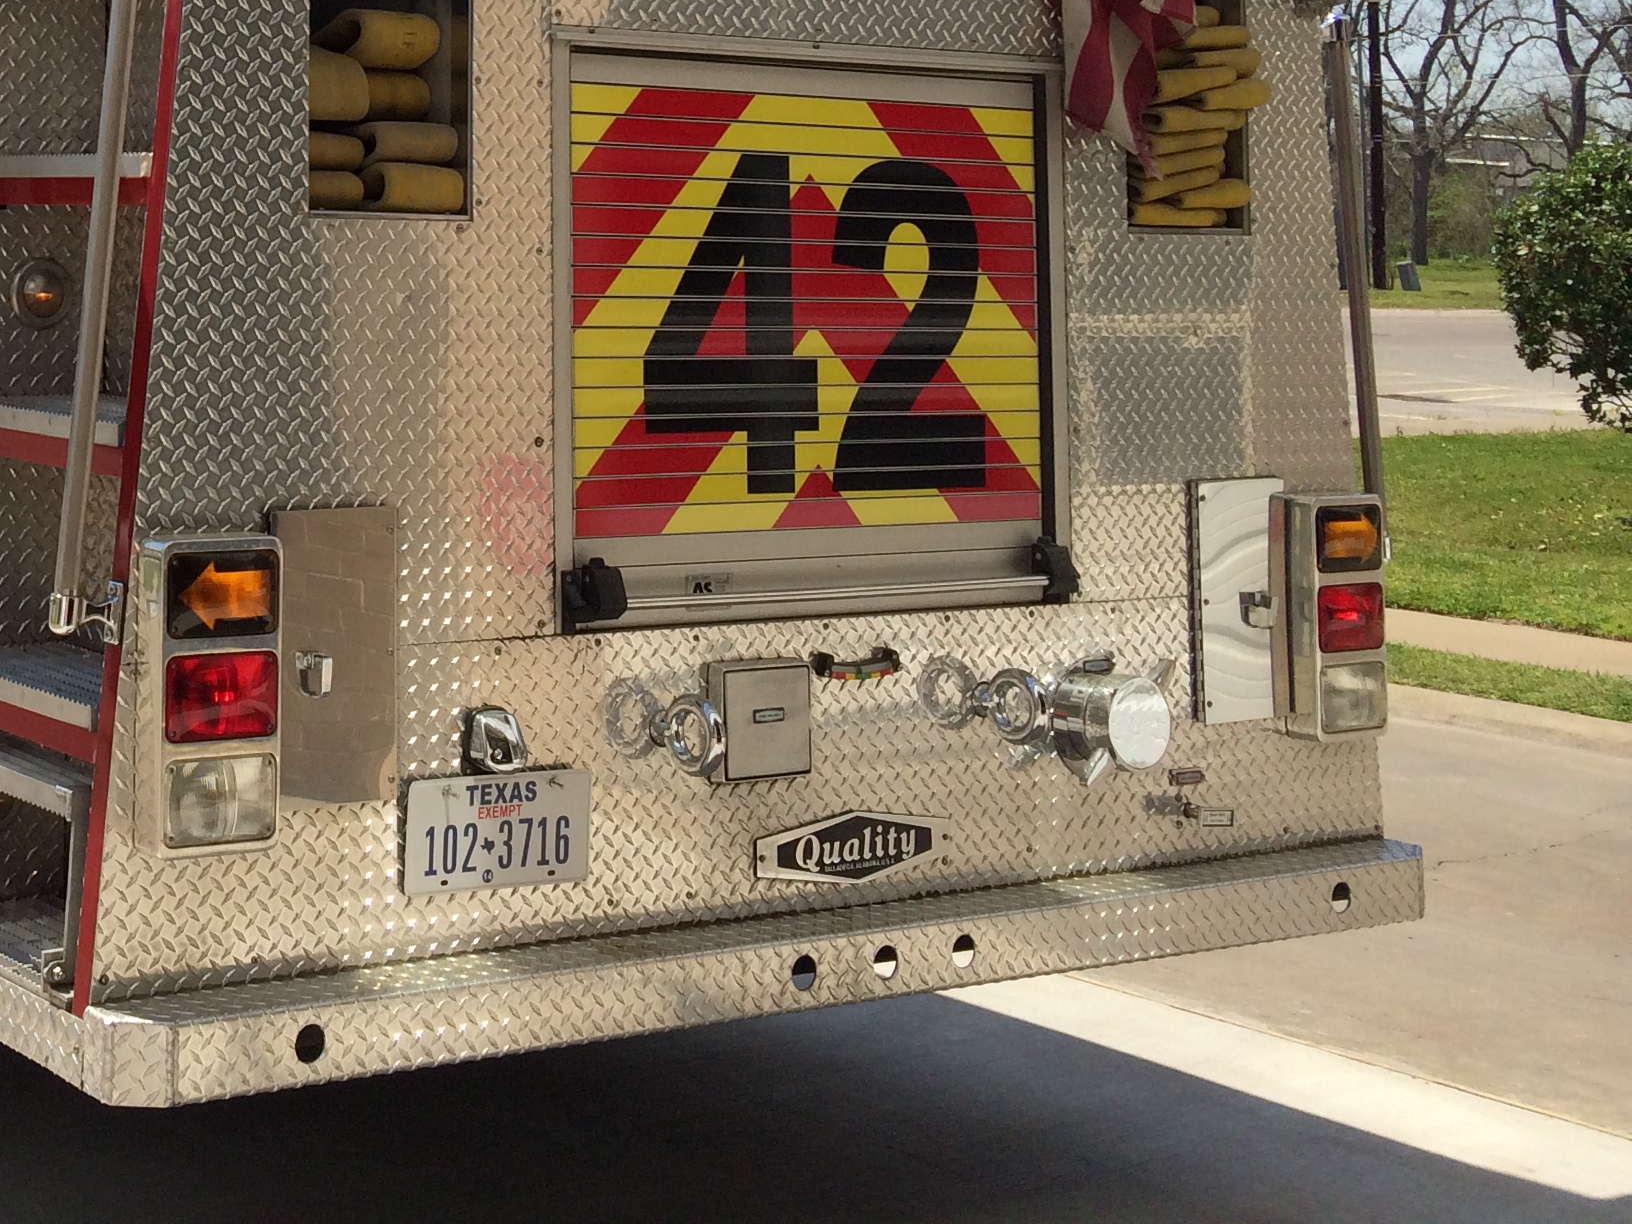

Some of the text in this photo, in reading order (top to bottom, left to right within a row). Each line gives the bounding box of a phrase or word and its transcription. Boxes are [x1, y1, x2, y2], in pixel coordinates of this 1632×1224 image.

[643, 152, 988, 495] 42
[465, 780, 538, 807] TEXAS
[477, 803, 523, 820] EXEMPT
[795, 824, 917, 873] Quality
